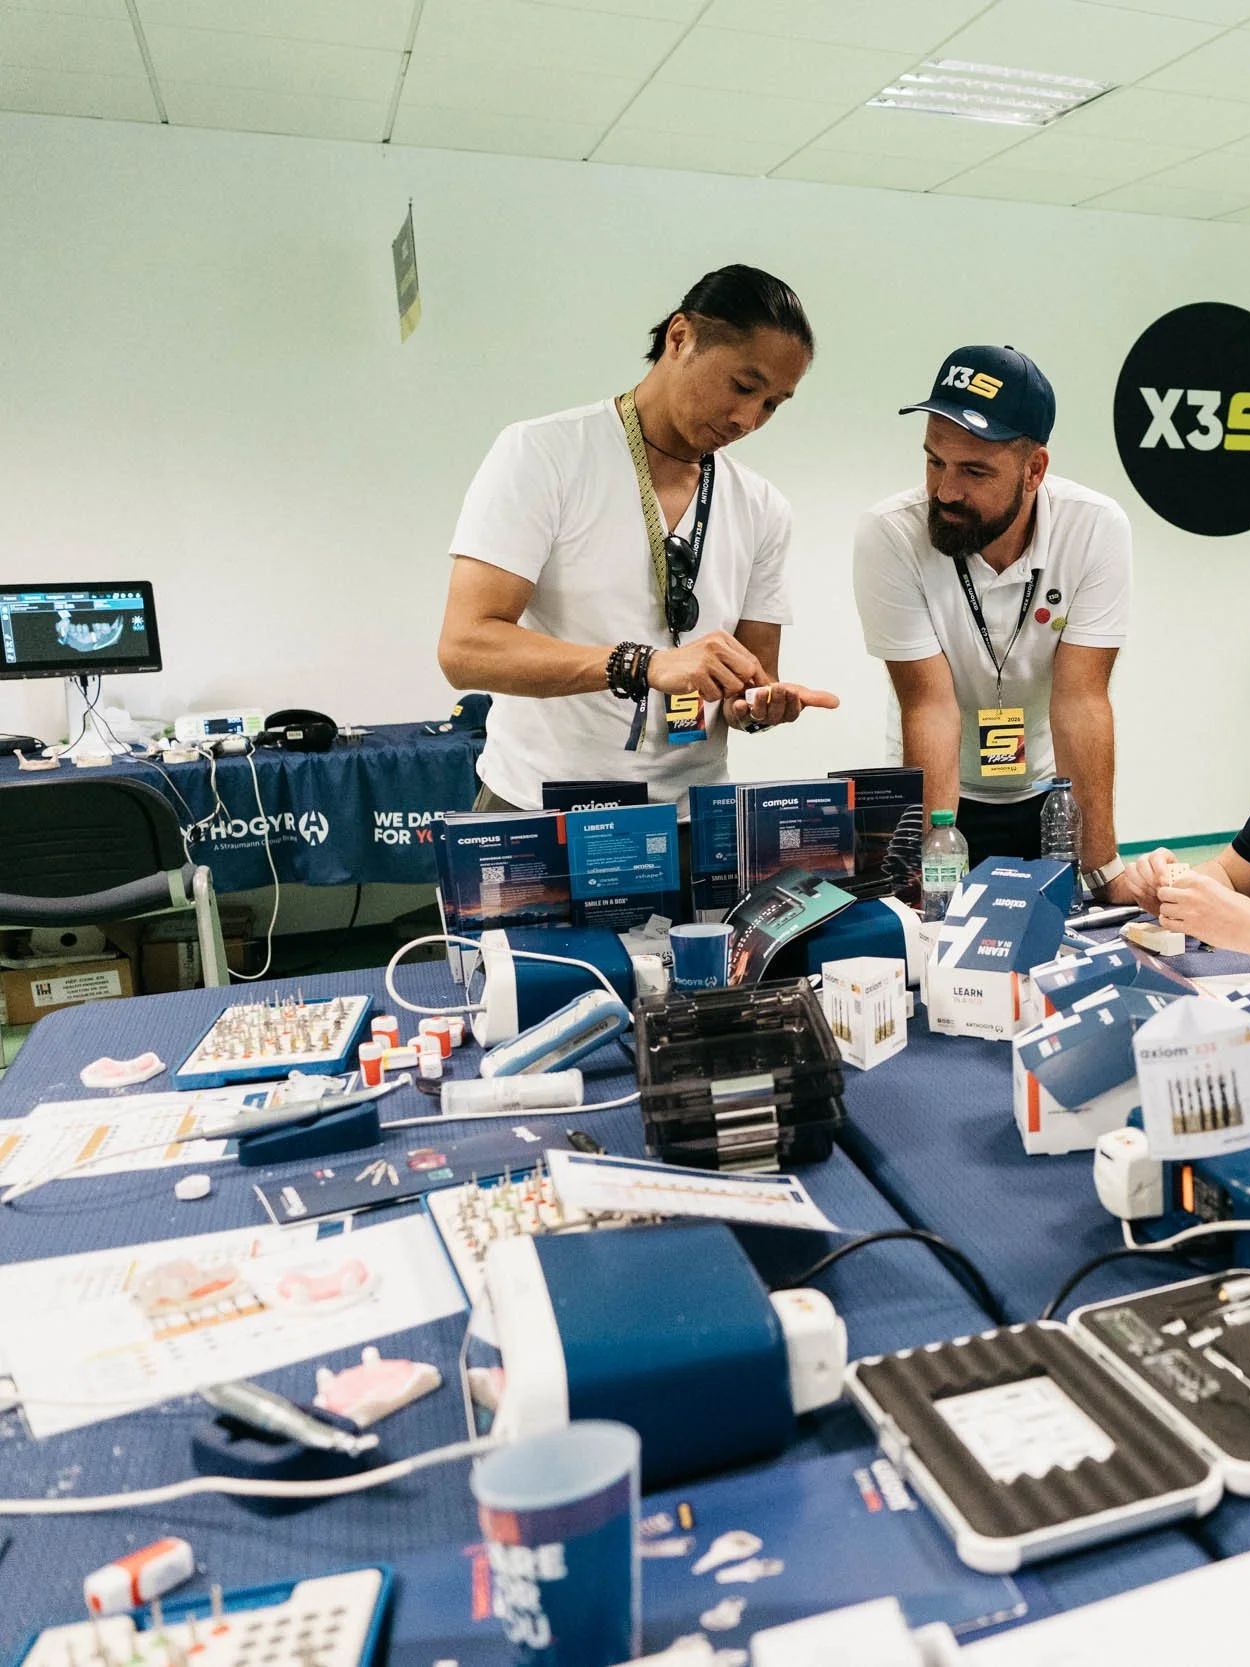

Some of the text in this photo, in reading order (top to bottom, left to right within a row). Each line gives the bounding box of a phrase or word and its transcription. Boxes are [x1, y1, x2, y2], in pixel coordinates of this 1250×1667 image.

[941, 365, 1004, 399] X3S
[701, 471, 710, 504] ANTHOGYR
[968, 587, 979, 611] axiom
[987, 754, 1017, 763] PASS
[762, 798, 799, 808] campus
[374, 811, 404, 827] WE
[583, 822, 615, 831] LIBERTÉ
[374, 828, 411, 845] FOR
[457, 835, 501, 845] campus
[221, 841, 260, 850] Straumann
[994, 898, 1027, 909] axiom
[977, 946, 1010, 957] LEARN
[953, 987, 983, 997] LEARN
[1140, 1047, 1188, 1059] axiom
